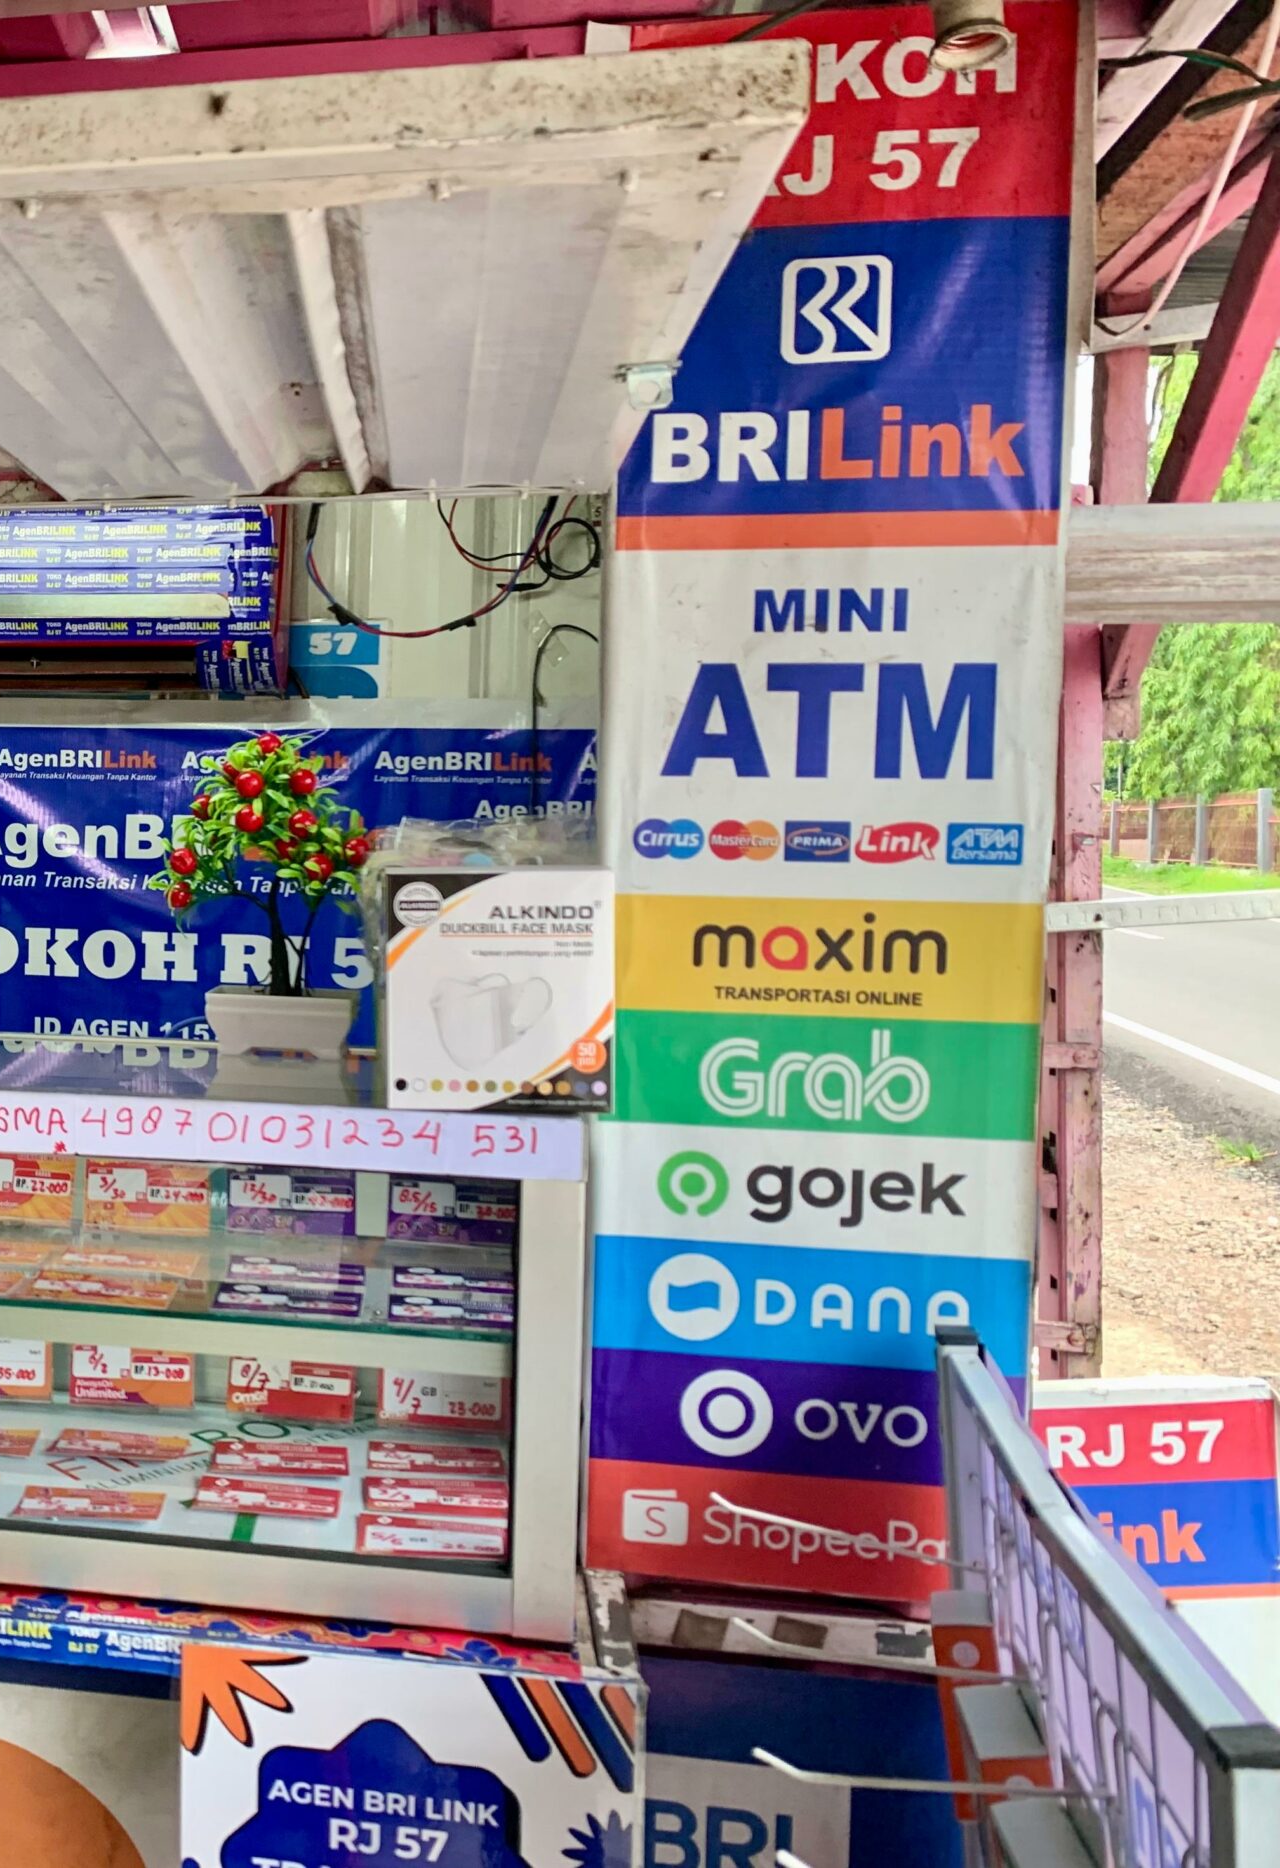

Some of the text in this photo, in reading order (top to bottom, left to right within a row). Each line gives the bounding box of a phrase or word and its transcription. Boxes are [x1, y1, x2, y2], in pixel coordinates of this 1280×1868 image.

[815, 34, 1016, 103] KOH
[868, 127, 980, 192] 57
[651, 404, 1026, 484] BRILink
[754, 588, 908, 632] MINI
[309, 632, 358, 655] 57
[660, 662, 998, 780] ATM
[375, 751, 552, 774] AgenBRILink
[637, 828, 700, 848] Cirrus
[710, 834, 779, 848] MasterCard
[793, 835, 845, 848] PRIMA
[860, 825, 936, 861] Link
[951, 848, 1018, 861] Bersama
[952, 827, 1018, 848] ATM
[44, 871, 136, 890] Transaksi
[440, 923, 593, 934] DUCKBILL FACE MASK
[489, 905, 594, 920] ALKINDO
[693, 912, 947, 975] maxim
[714, 986, 923, 1007] TRANSPORTASI ONLINE
[34, 1016, 148, 1038] ID AGEN
[578, 1044, 596, 1057] 50
[699, 1029, 930, 1123] Grab
[81, 1107, 192, 1137] 4987
[208, 1111, 442, 1155] 01031234
[472, 1125, 538, 1157] 531
[747, 1162, 967, 1228] gojek
[754, 1278, 970, 1337] DANA
[794, 1398, 928, 1448] OVO
[1046, 1419, 1224, 1469] RJ 57
[268, 1779, 499, 1828] AGEN BRI LINK
[329, 1818, 449, 1862] RJ 57
[645, 1798, 792, 1868] BRI
